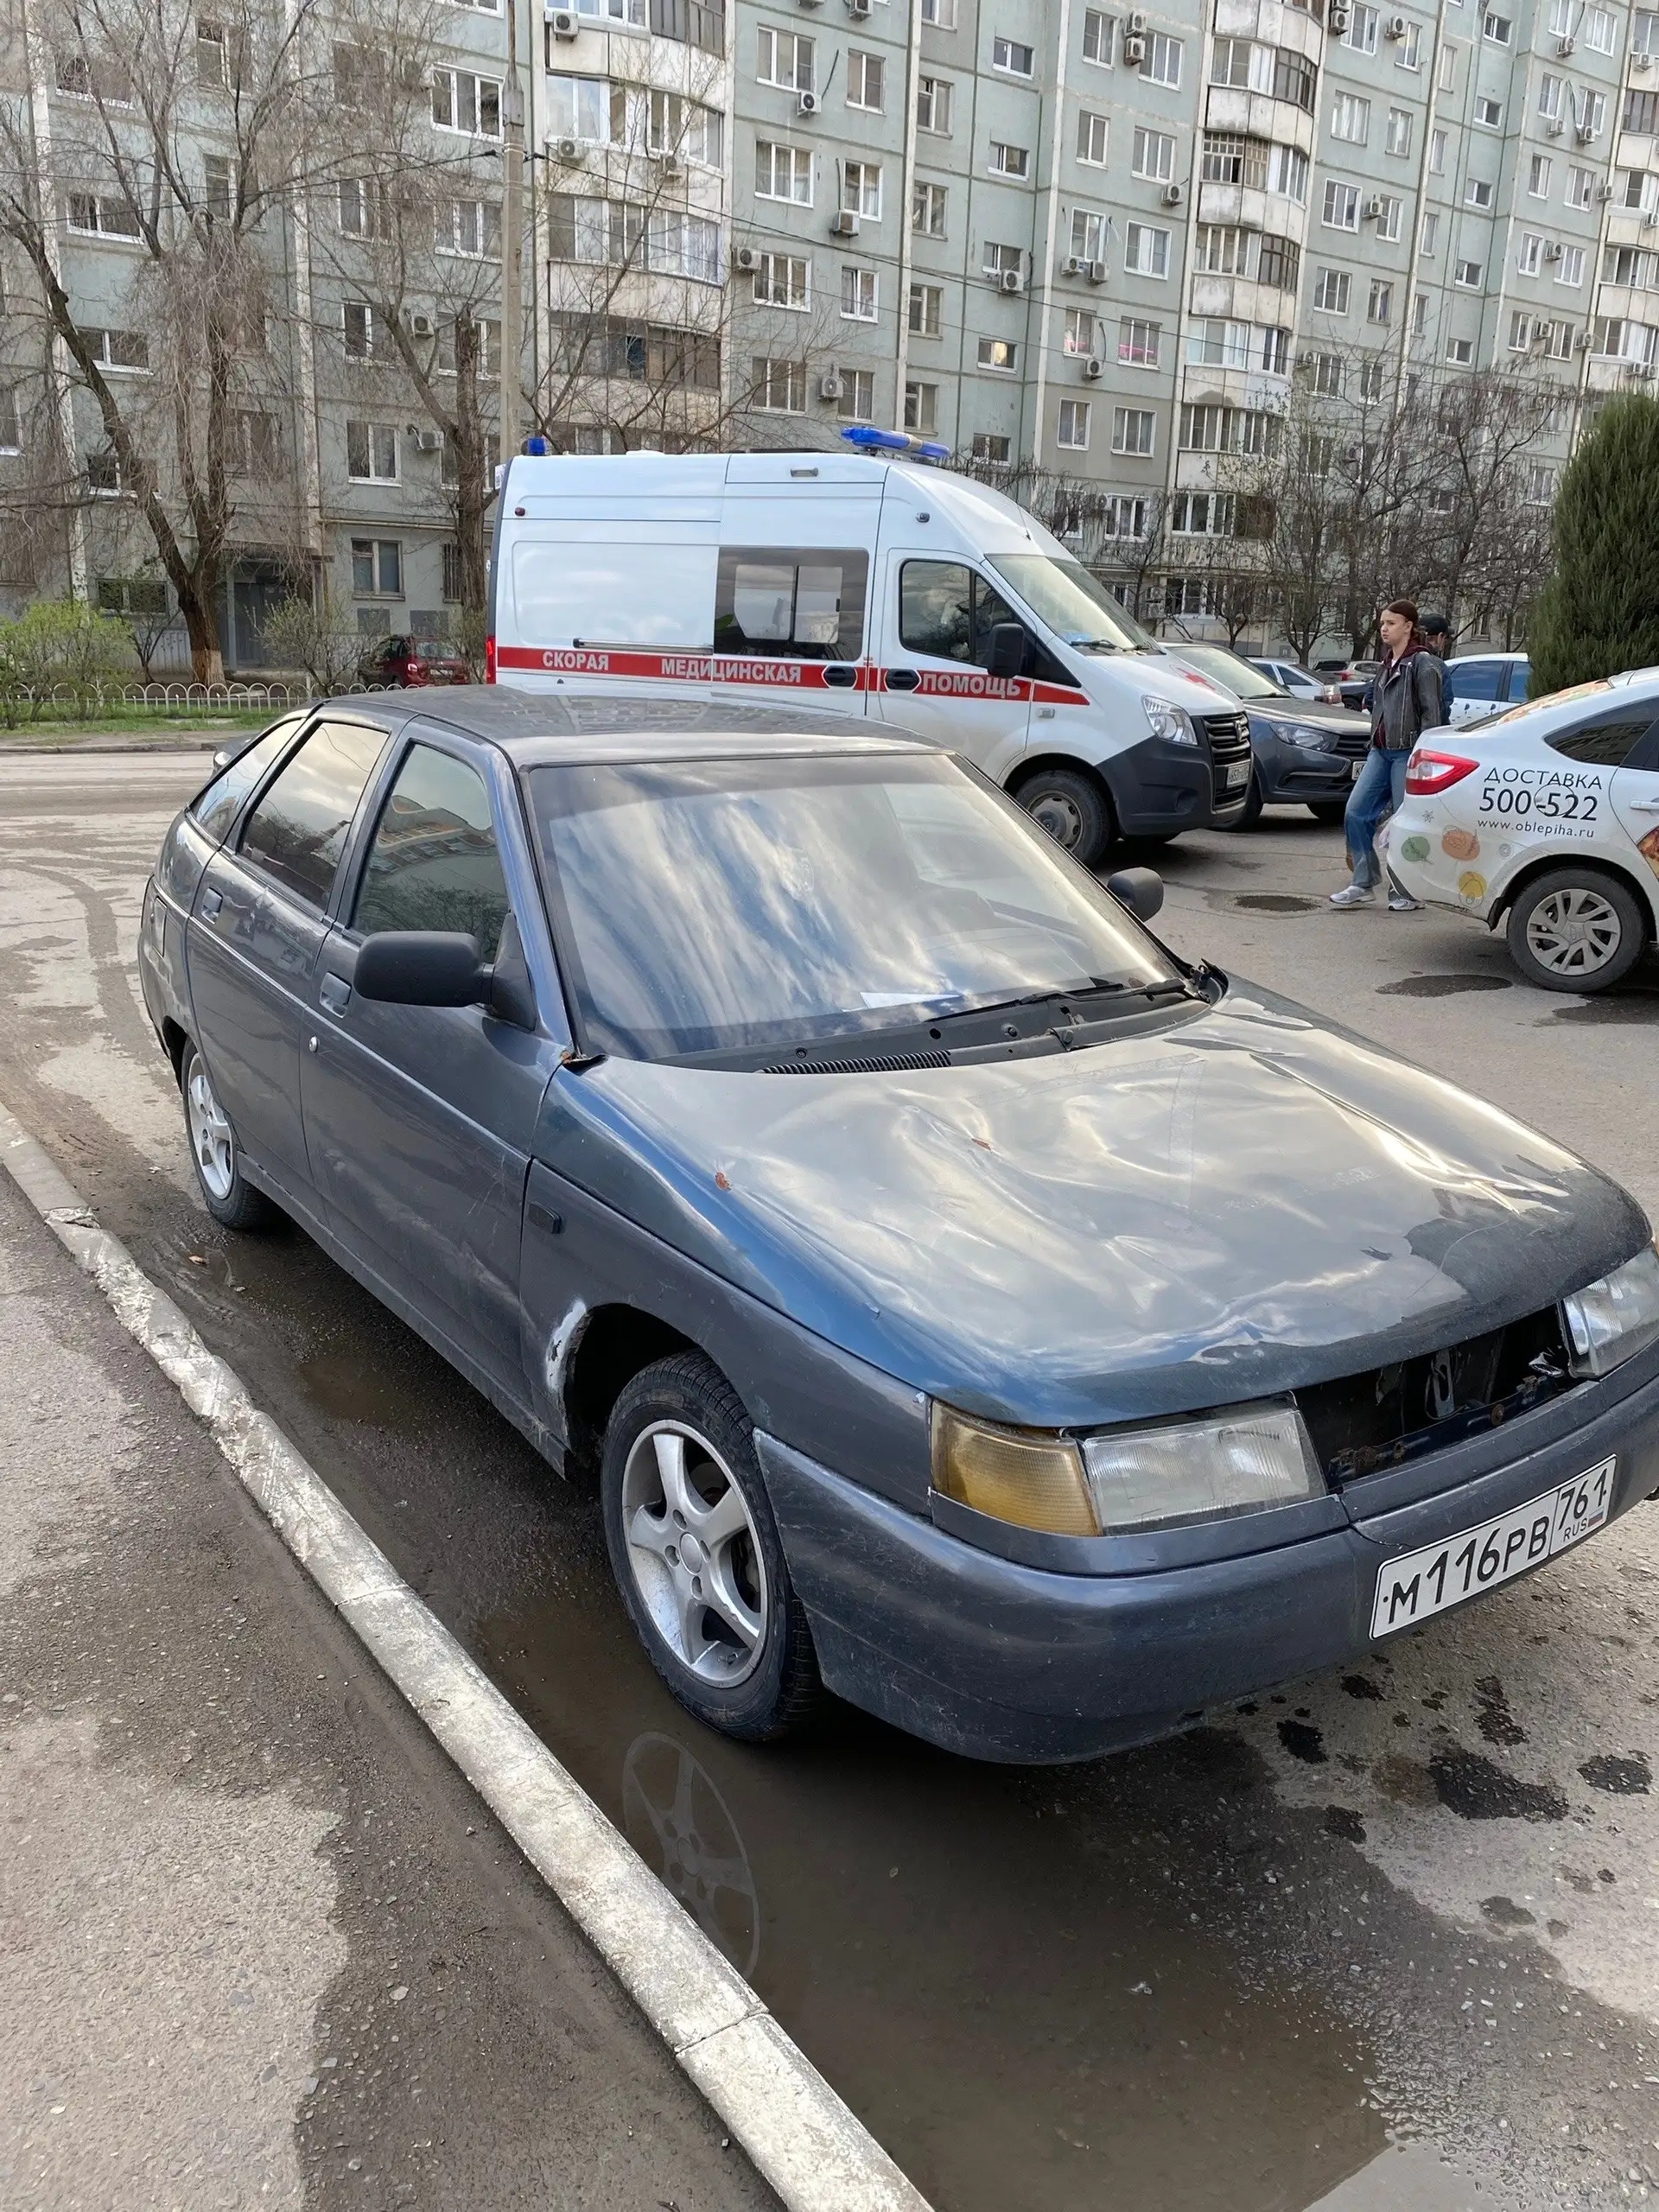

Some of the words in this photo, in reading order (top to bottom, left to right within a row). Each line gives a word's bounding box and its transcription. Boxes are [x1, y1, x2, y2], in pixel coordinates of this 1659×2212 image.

[543, 651, 609, 671] СКОРАЯ
[661, 658, 801, 683] МЕДИЦИНСКАЯ
[922, 673, 1020, 699] ПОМОЩЬ
[1484, 766, 1602, 790] ДОСТАВКА
[1478, 787, 1598, 822] 500-522
[1478, 819, 1594, 838] www.oblepiha.ru
[1558, 1467, 1608, 1531] 761
[1562, 1517, 1588, 1543] RUS
